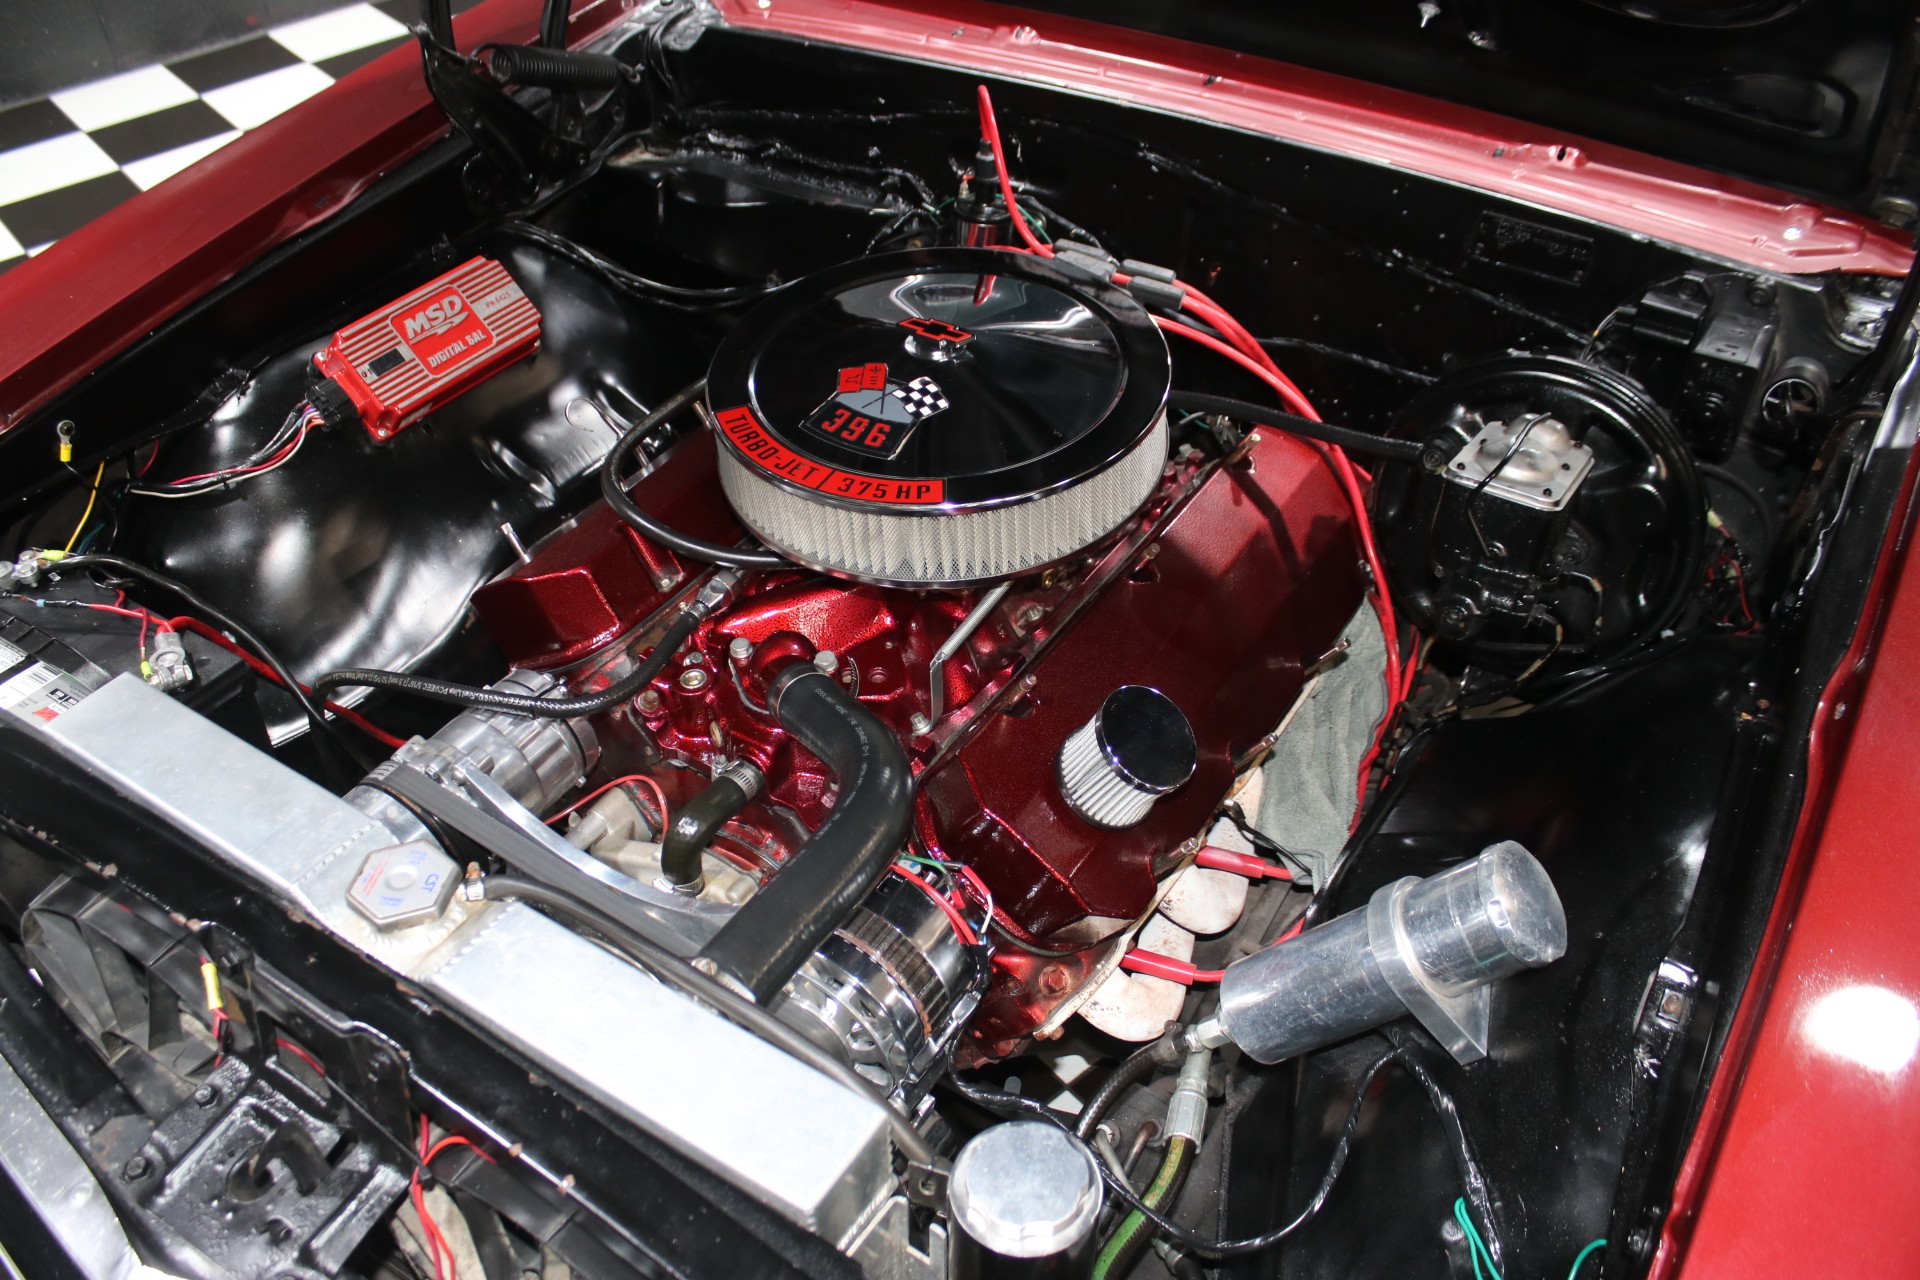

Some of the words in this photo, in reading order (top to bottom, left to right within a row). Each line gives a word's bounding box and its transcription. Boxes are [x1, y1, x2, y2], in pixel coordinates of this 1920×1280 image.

[404, 295, 462, 338] MSD
[428, 343, 467, 368] DIGITAL
[467, 330, 486, 345] 6AL
[822, 408, 892, 448] 396
[725, 414, 820, 482] TURBO-JET
[837, 478, 888, 499] 375
[896, 485, 931, 500] HP
